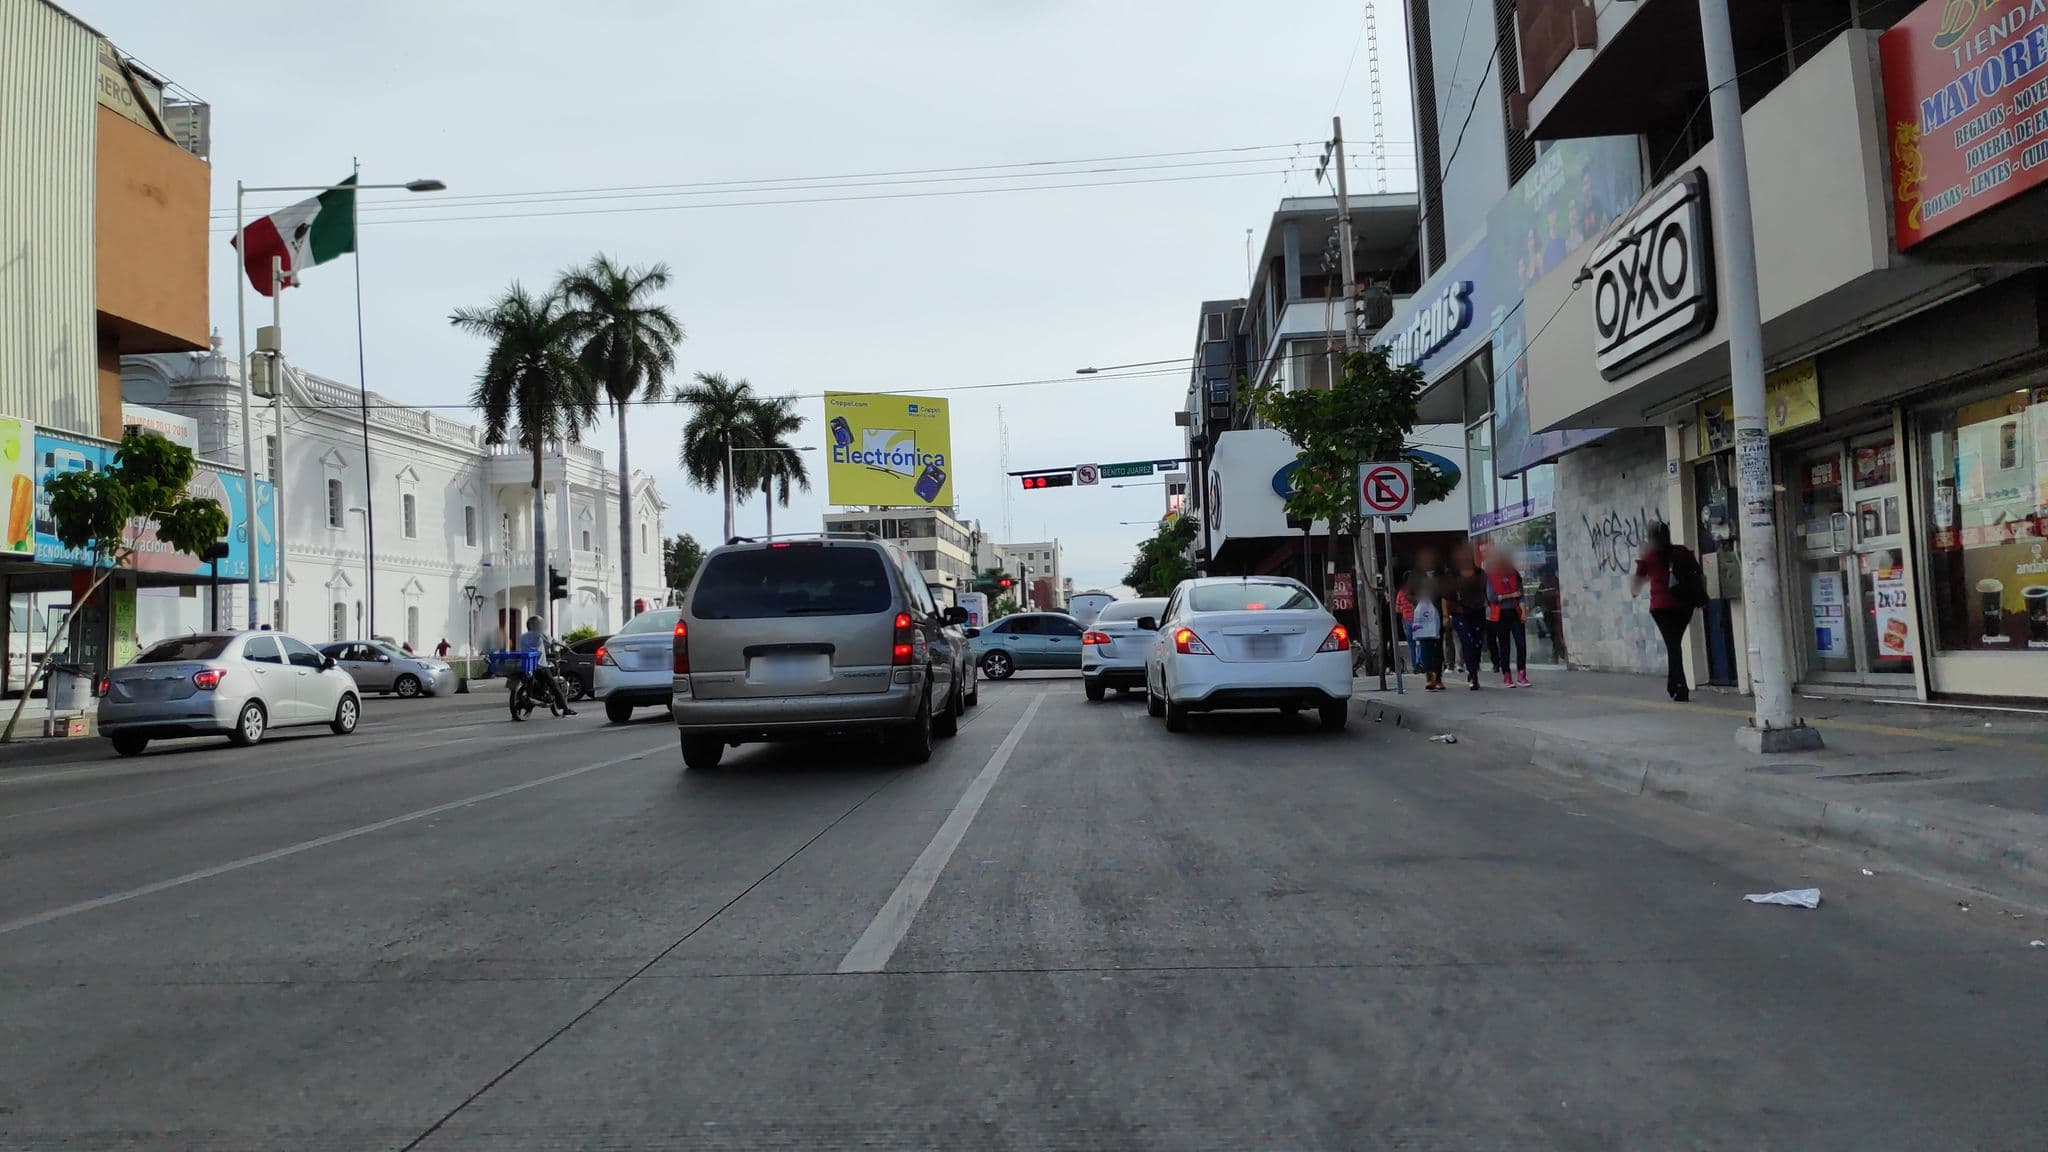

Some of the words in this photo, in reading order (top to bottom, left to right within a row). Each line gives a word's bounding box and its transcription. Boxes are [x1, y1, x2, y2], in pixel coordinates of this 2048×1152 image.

[1954, 103, 2006, 149] REGALOS
[2015, 117, 2034, 146] DE
[1922, 184, 1963, 222] BOLSAS
[1970, 158, 2012, 198] LENTES
[1596, 222, 1688, 342] OXXO
[833, 444, 945, 467] Electrónica
[1102, 467, 1125, 477] BENITO
